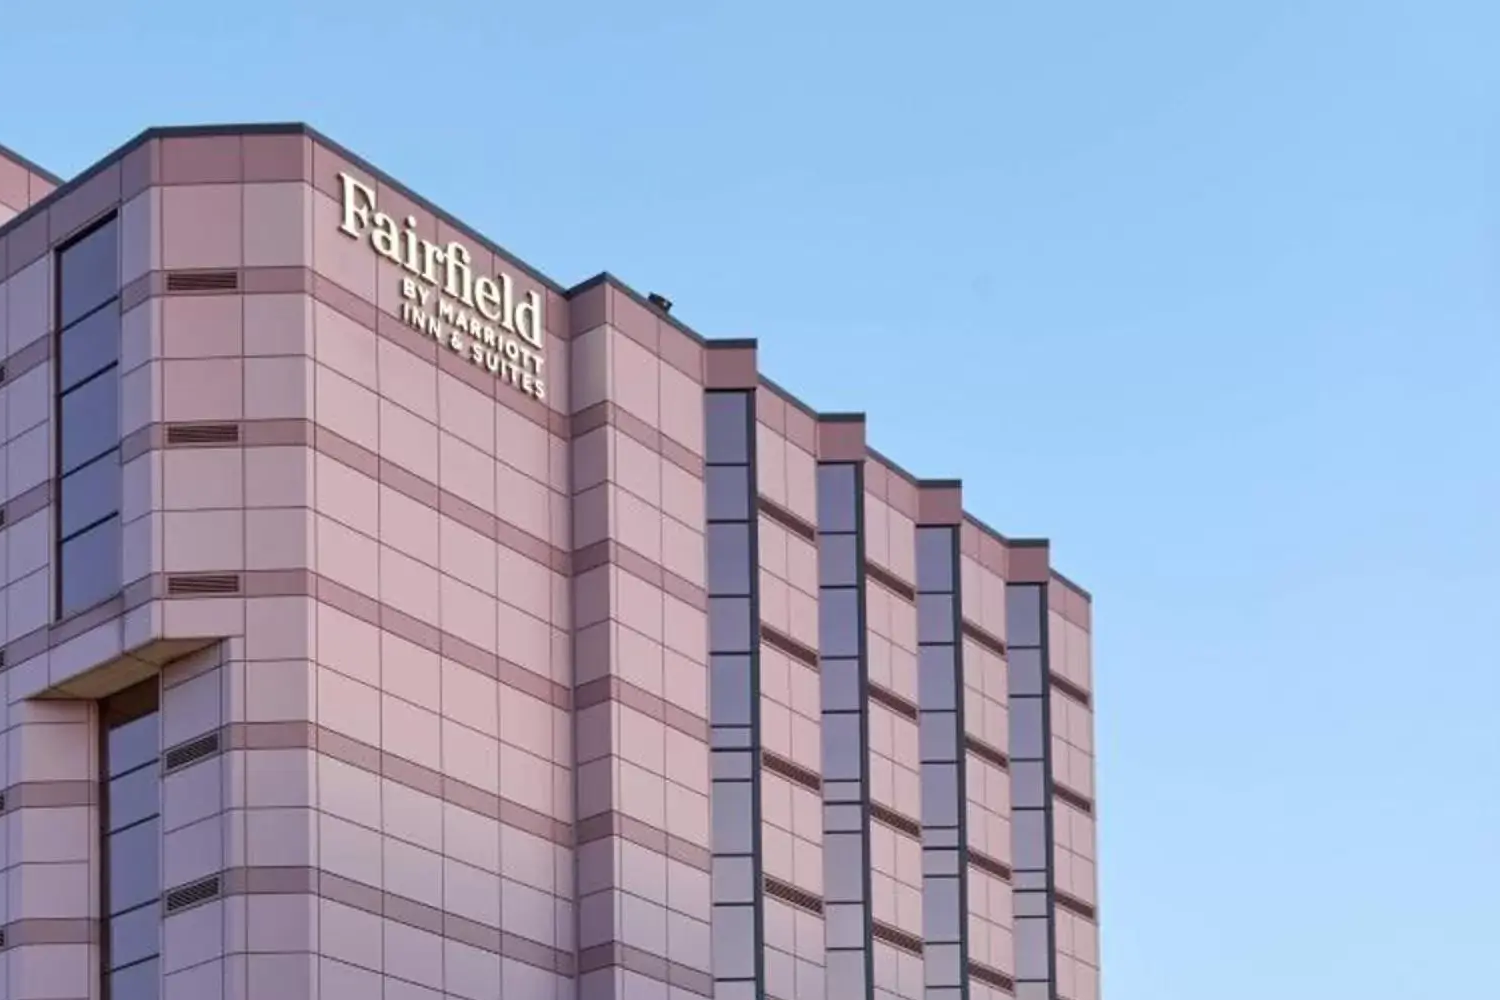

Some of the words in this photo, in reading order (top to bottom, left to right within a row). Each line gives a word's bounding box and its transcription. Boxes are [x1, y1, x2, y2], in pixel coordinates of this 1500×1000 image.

[338, 171, 543, 350] Fairfield
[402, 277, 430, 308] BY
[437, 297, 544, 373] MARRIOTT
[402, 302, 442, 340] INN
[450, 329, 464, 352] &
[471, 342, 546, 400] SUITES
